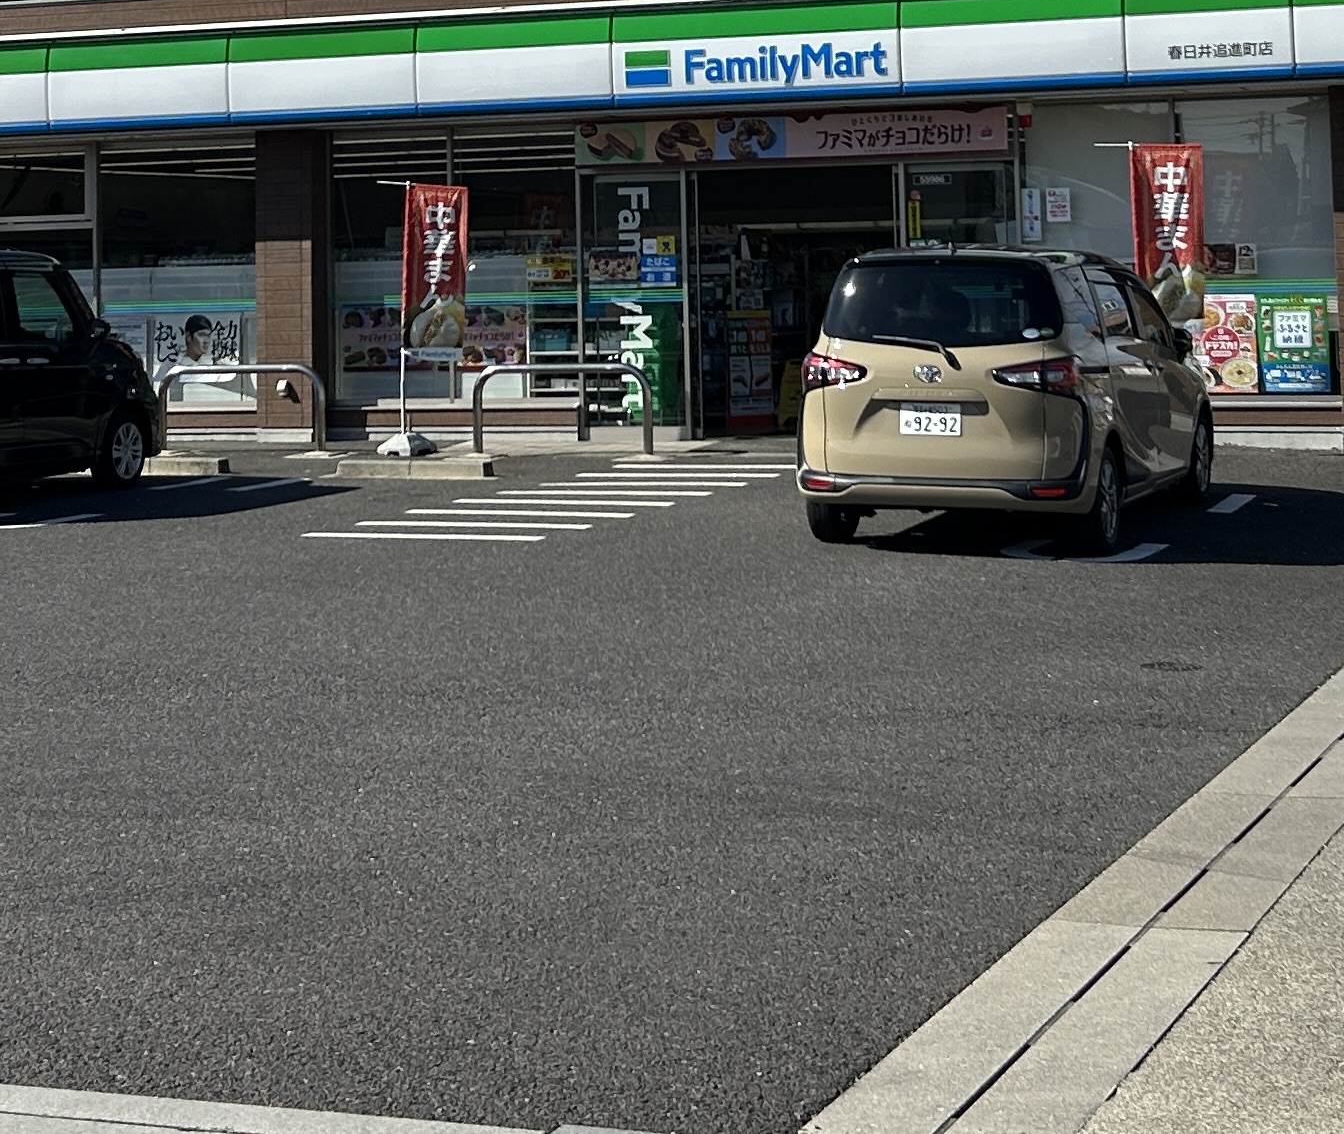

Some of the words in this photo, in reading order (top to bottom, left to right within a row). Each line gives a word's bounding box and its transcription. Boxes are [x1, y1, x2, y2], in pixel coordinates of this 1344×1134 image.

[684, 41, 887, 86] FamilyMart
[419, 201, 456, 309] 中華まん
[1154, 162, 1192, 279] 中華まん
[914, 416, 958, 433] 92-92
